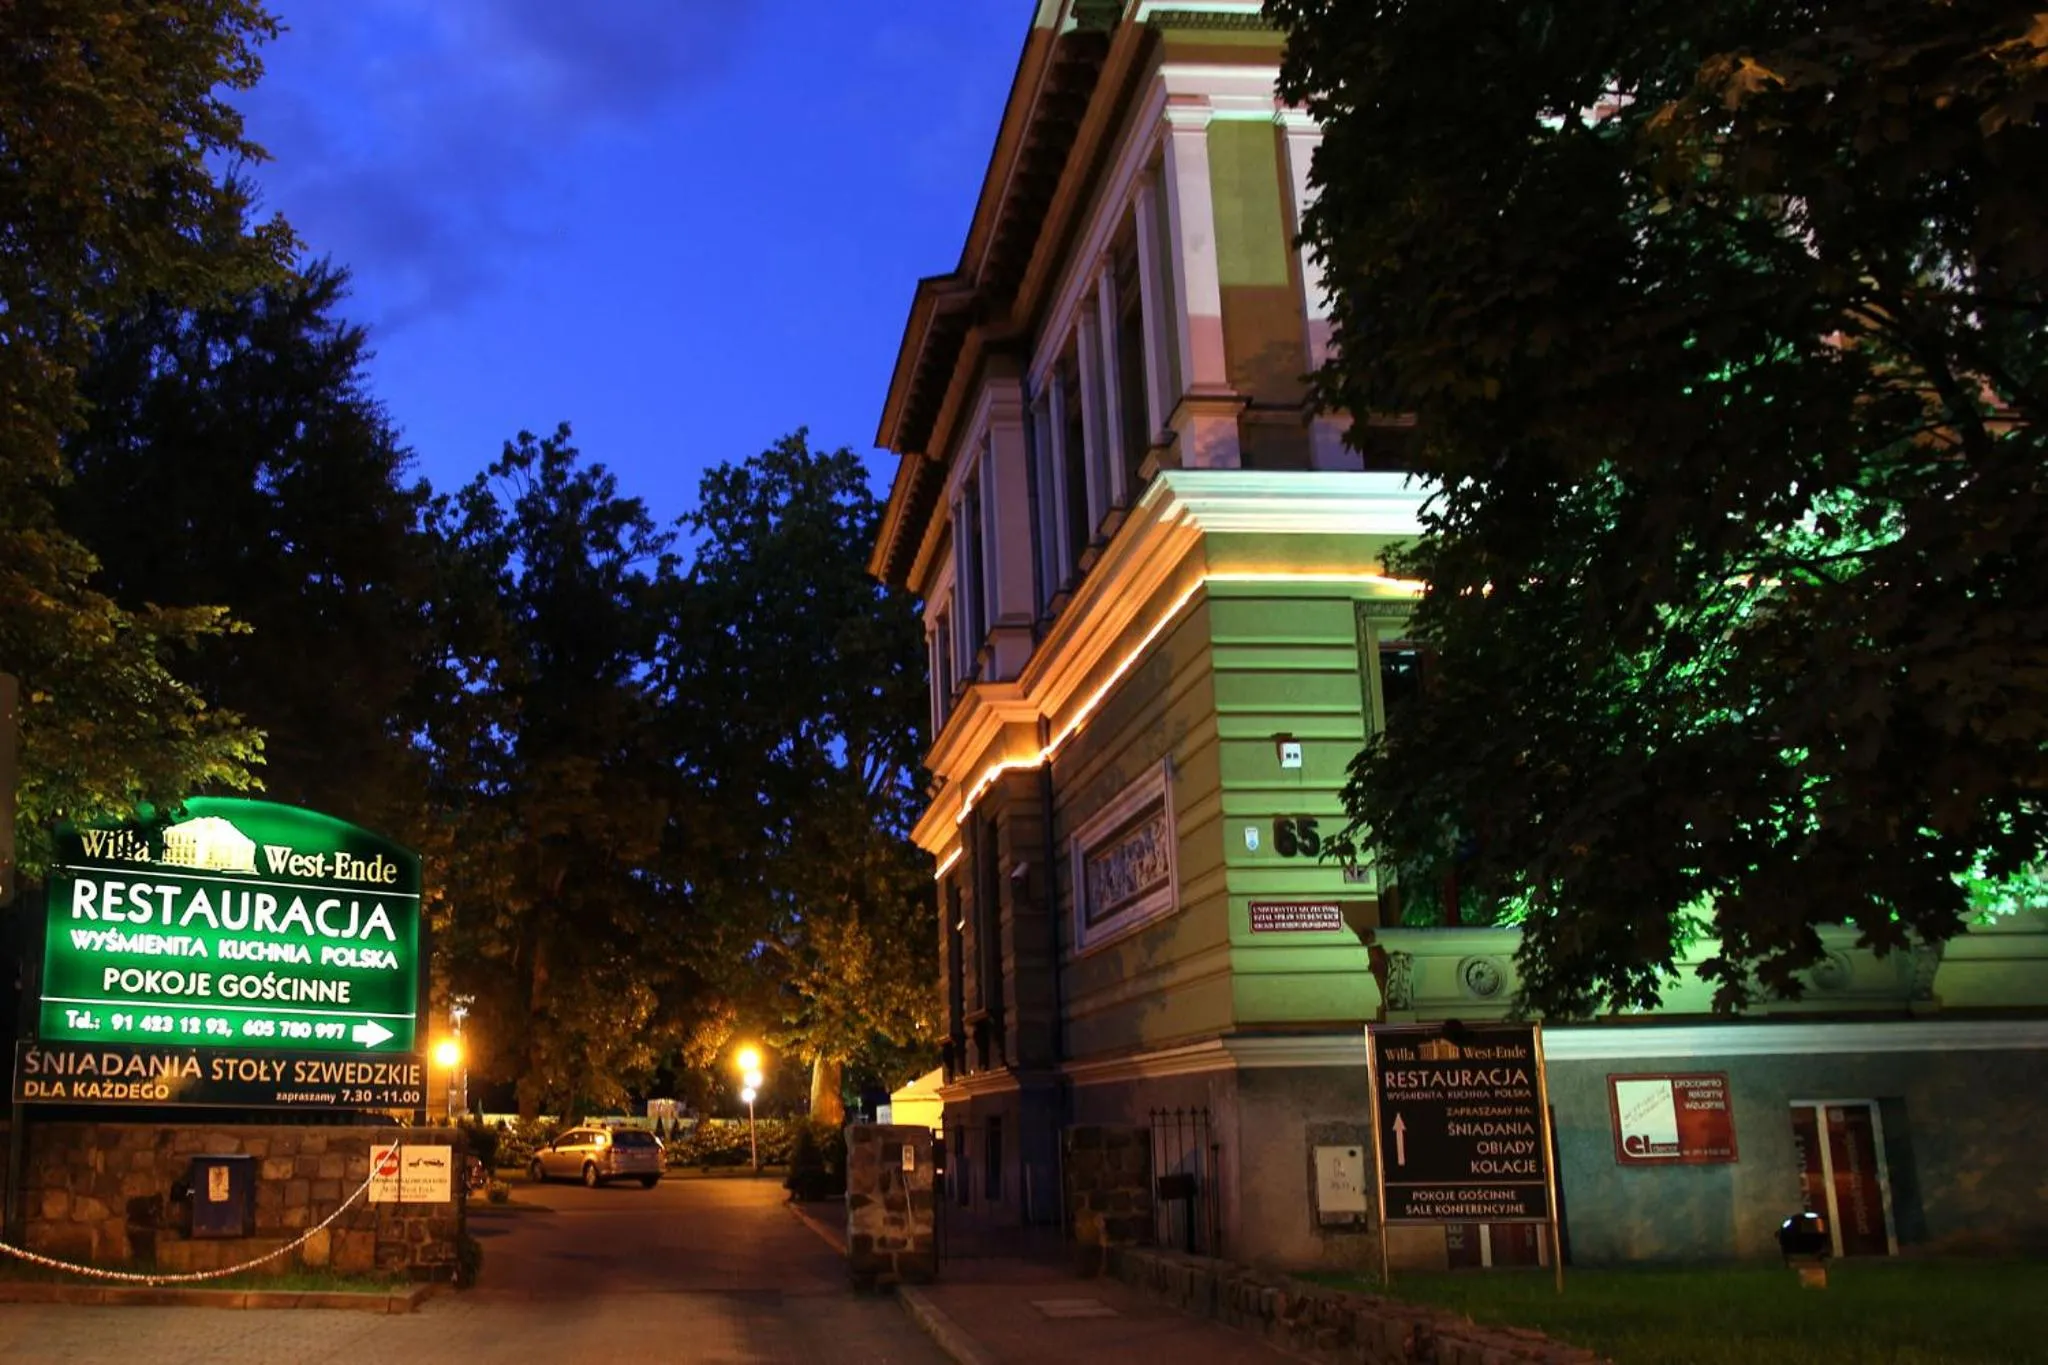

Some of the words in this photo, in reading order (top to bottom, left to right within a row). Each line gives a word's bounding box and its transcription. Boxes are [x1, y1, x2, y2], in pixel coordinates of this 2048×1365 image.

[1273, 815, 1321, 858] 65
[82, 829, 151, 863] Willa
[263, 844, 398, 884] West-Ende
[72, 879, 397, 941] RESTAURACJA
[70, 926, 208, 959] WYŚMIENITA
[218, 939, 312, 966] KUCHNIA
[320, 947, 399, 970] POLSKA
[103, 967, 211, 997] POKOJE
[218, 971, 351, 1004] GOŚCINNE
[111, 1013, 133, 1031] 91
[140, 1015, 173, 1033] 423
[242, 1019, 275, 1037] 605
[279, 1021, 311, 1038] 780
[314, 1022, 347, 1040] 997
[1385, 1048, 1416, 1061] Willa
[1463, 1045, 1527, 1060] West-Ende
[24, 1050, 202, 1080] ŚNIADANIA
[211, 1058, 287, 1084] STOŁY
[294, 1060, 421, 1086] SZWEDZKIE
[1385, 1068, 1528, 1088] RESTAURACJA
[24, 1080, 67, 1098] DLA
[72, 1078, 169, 1099] KAŻDEGO
[276, 1090, 337, 1104] zapraszamy
[342, 1089, 373, 1103] 7.30
[1387, 1090, 1444, 1100] WYŚMIENITA
[1447, 1090, 1490, 1099] KUCHNIA
[1494, 1088, 1532, 1098] POLSKA
[1688, 1090, 1724, 1099] reklamy
[1446, 1106, 1512, 1117] ZAPRASZAMY
[1515, 1105, 1531, 1116] NA
[1447, 1120, 1534, 1136] ŚNIADANIA
[1477, 1141, 1535, 1155] OBIADY
[1471, 1159, 1537, 1174] KOLACJE
[1412, 1190, 1456, 1201] POKOJE
[1459, 1188, 1516, 1201] GOŚCINNE
[1405, 1204, 1431, 1215] SALE
[1435, 1204, 1525, 1215] KONFERENCYJNE
